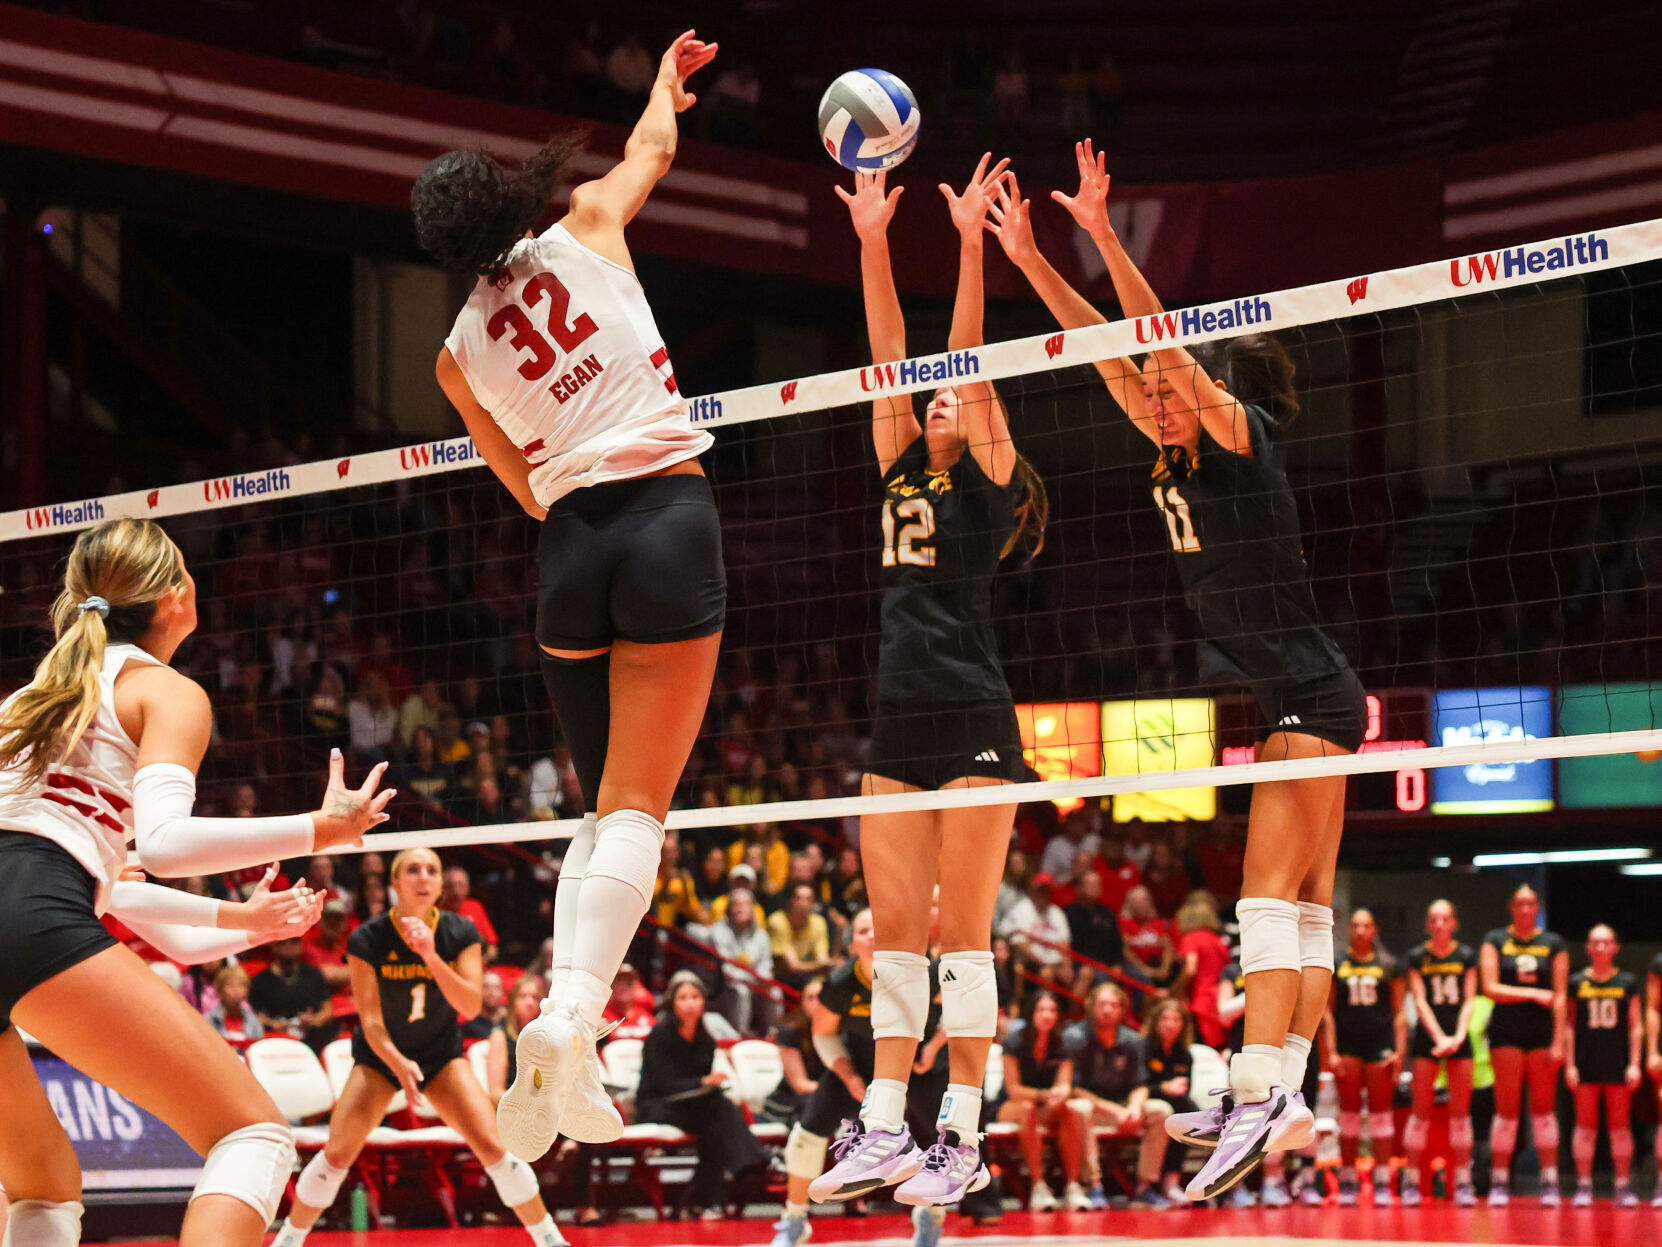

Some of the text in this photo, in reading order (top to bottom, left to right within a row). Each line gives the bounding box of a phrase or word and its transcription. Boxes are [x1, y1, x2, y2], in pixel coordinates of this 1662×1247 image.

[486, 271, 600, 382] 32
[548, 353, 605, 405] EGAN
[881, 498, 937, 567] 12
[1152, 486, 1202, 553] 11
[1396, 767, 1426, 812] 0
[1431, 974, 1460, 1006] 14
[1515, 953, 1538, 984] 2
[408, 982, 427, 1024] 1
[1588, 997, 1619, 1030] 10
